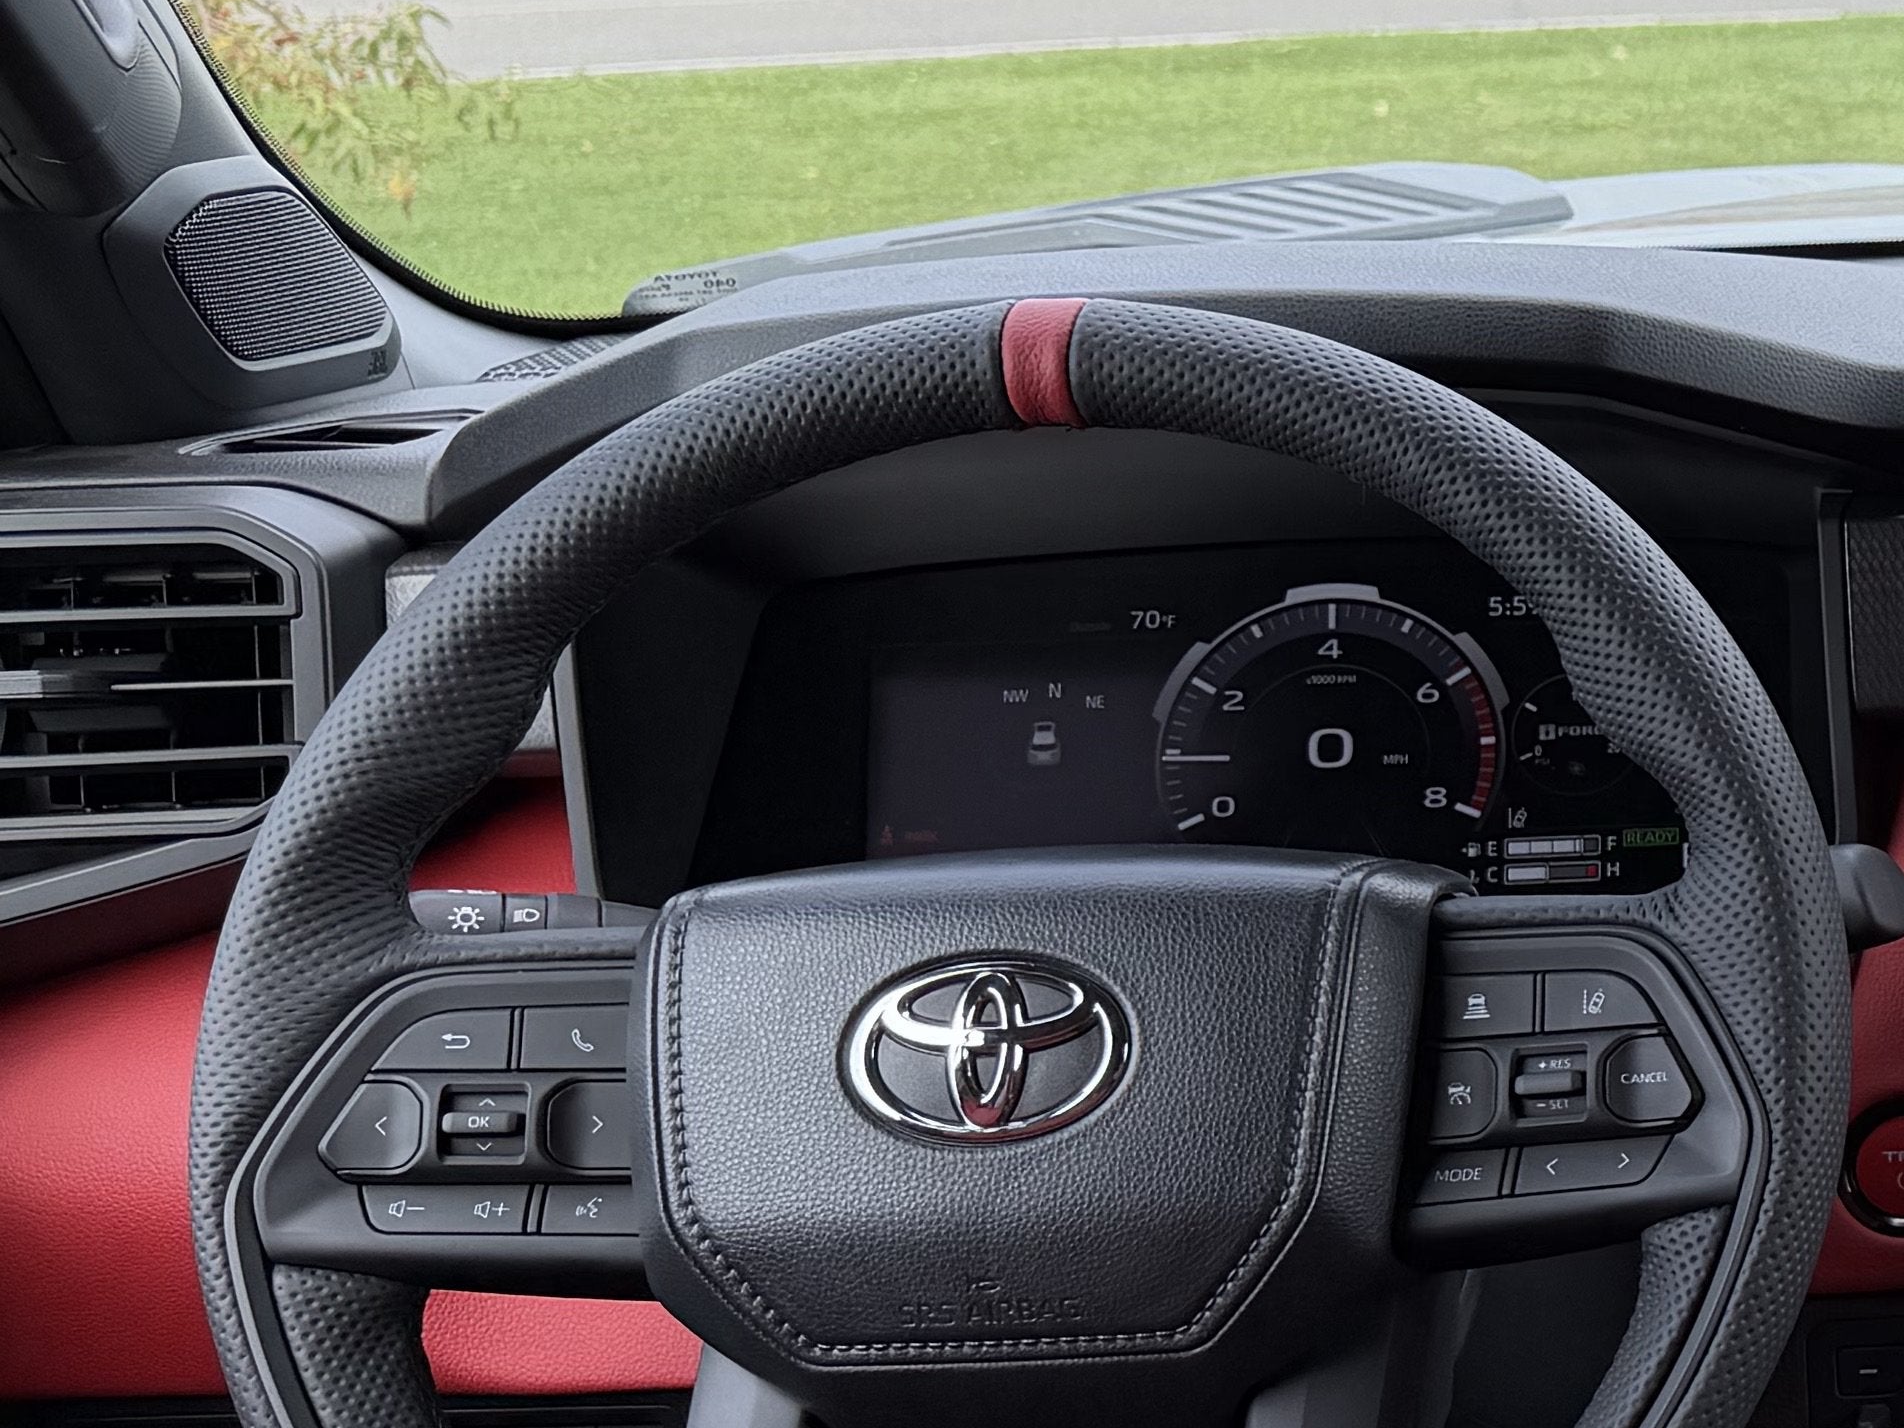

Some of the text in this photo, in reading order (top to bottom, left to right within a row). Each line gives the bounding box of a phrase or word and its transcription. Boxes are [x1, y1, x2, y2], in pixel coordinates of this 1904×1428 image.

[1488, 595, 1537, 617] 5:5
[1317, 638, 1343, 660] 4
[1003, 689, 1029, 704] NW
[1048, 682, 1062, 699] N
[1221, 690, 1246, 711] 2
[1416, 682, 1441, 704] 6
[1085, 694, 1105, 709] NE
[1308, 728, 1354, 769] 0
[1382, 754, 1410, 766] MPH
[1211, 795, 1236, 818] 0
[1422, 786, 1449, 808] 8
[1487, 835, 1618, 857] E F
[1626, 829, 1678, 846] READY
[1487, 861, 1621, 884] C H
[1620, 1071, 1668, 1084] CANCEL
[467, 1115, 491, 1130] OK
[1434, 1167, 1483, 1183] MODE
